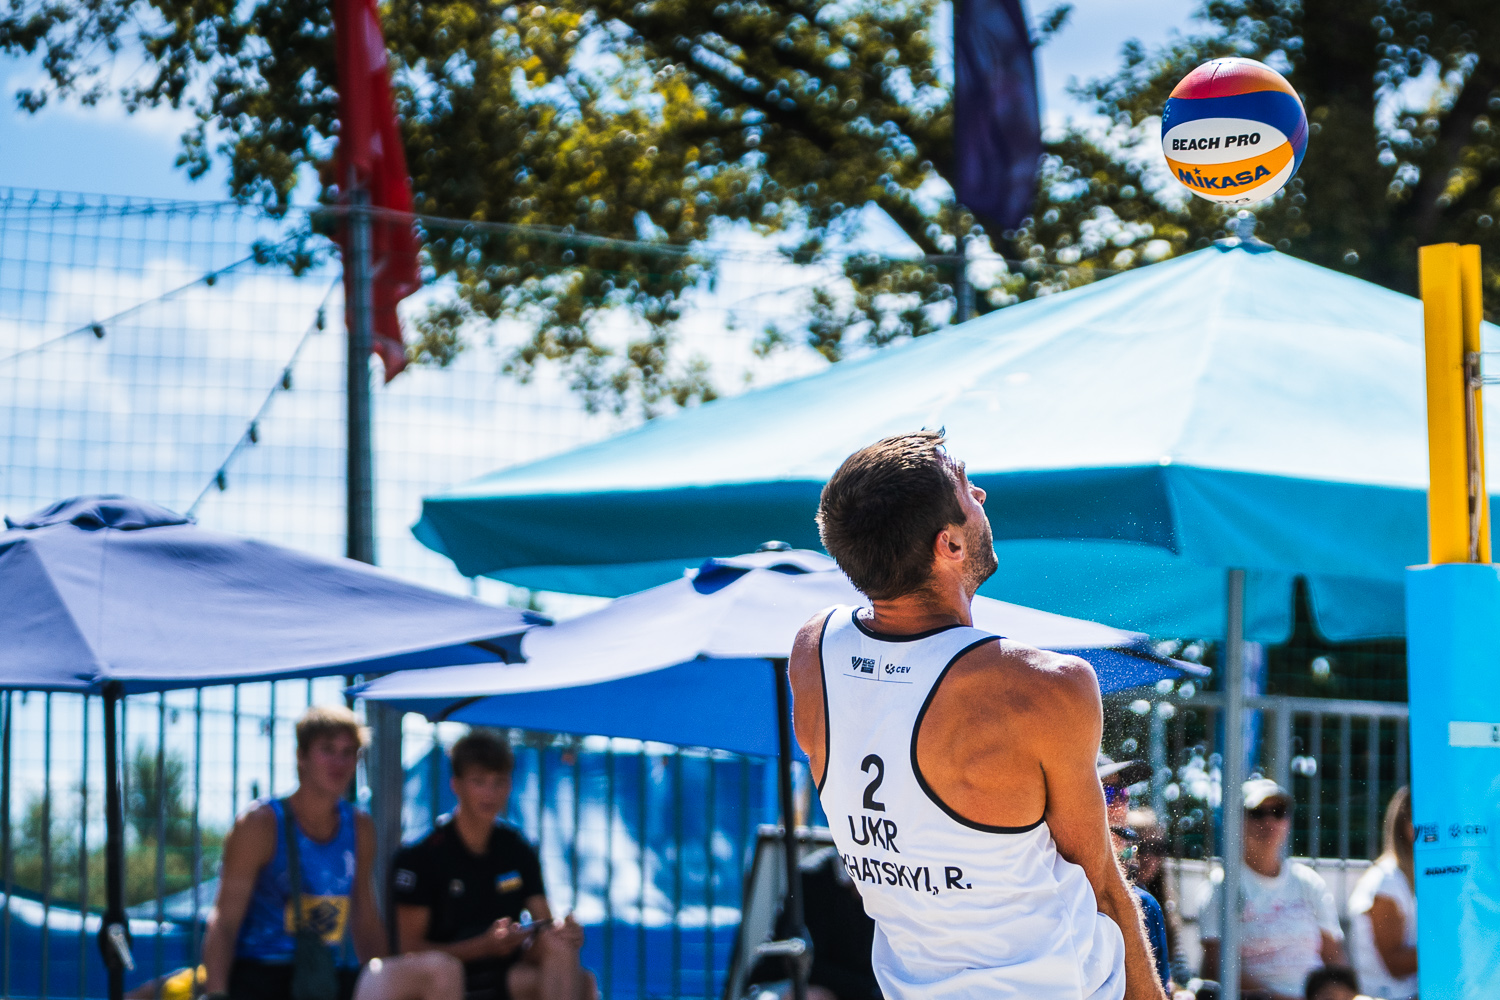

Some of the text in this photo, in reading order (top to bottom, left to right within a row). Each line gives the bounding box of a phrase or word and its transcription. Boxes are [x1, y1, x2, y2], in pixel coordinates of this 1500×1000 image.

[1172, 132, 1262, 151] BEACH PRO
[896, 666, 911, 674] CEV
[859, 753, 886, 812] 2
[847, 815, 901, 853] UKR
[944, 866, 972, 889] R.
